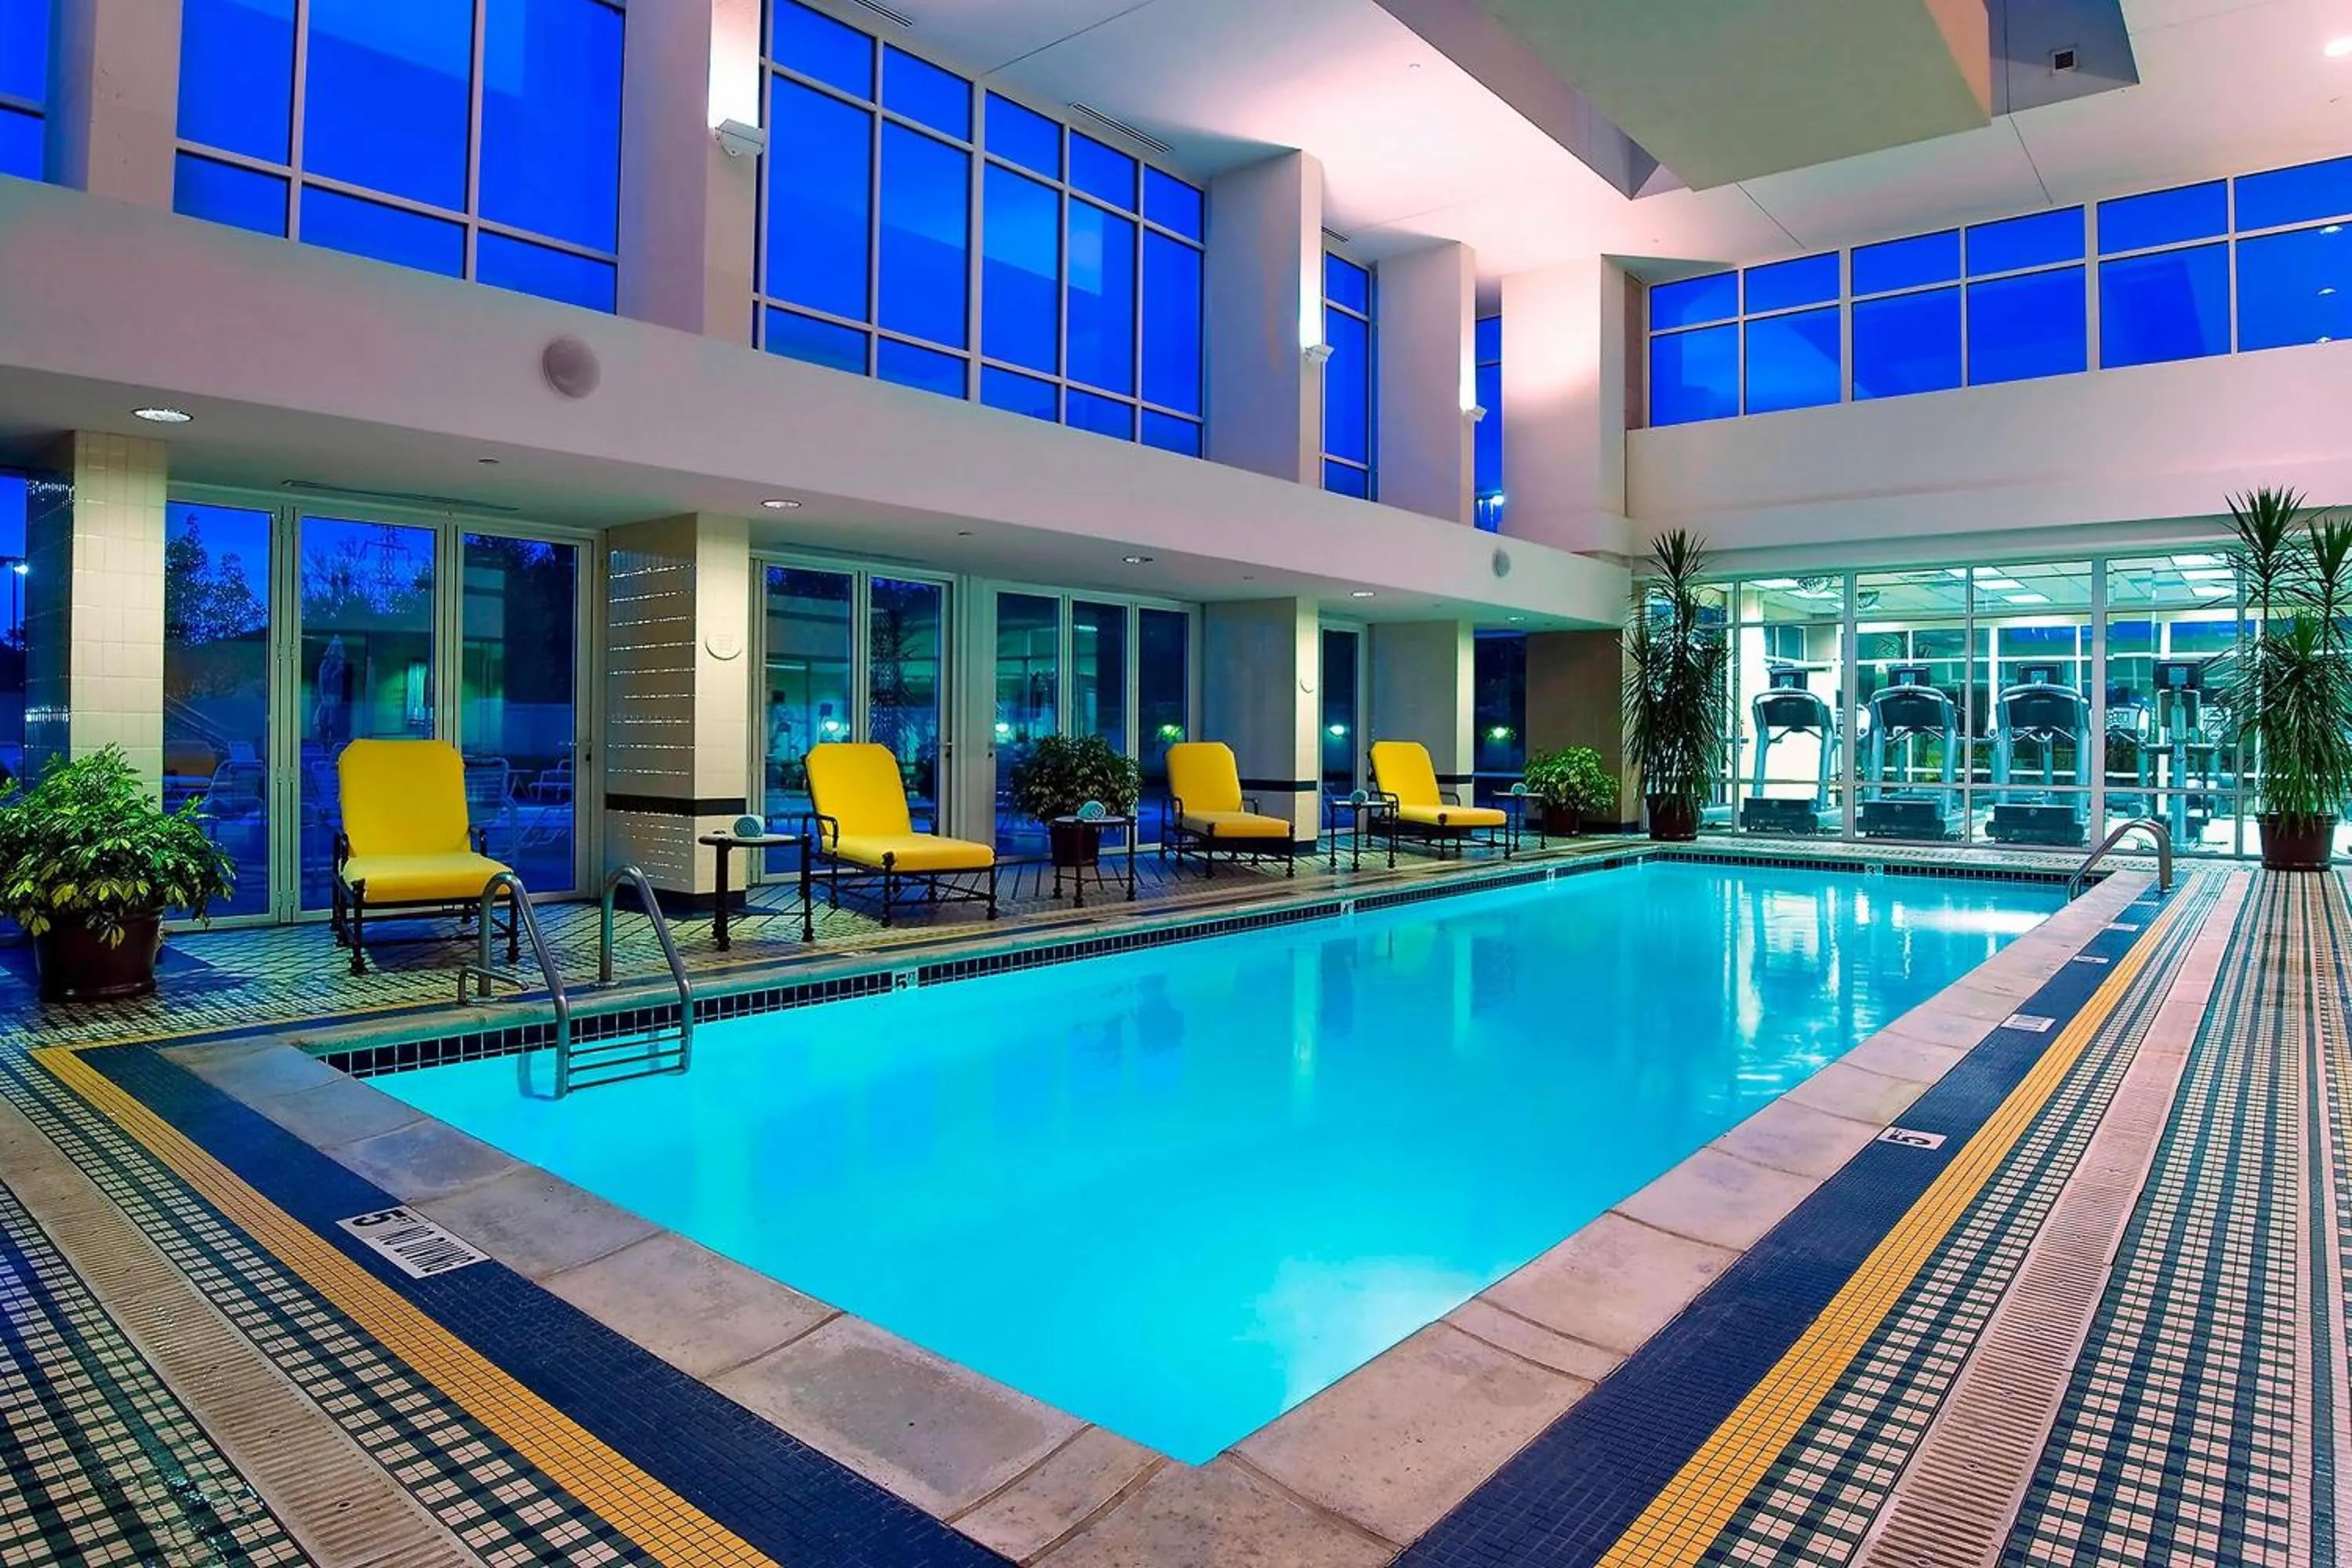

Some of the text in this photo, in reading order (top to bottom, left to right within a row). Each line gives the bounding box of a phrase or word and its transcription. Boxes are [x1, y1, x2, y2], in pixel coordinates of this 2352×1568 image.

[895, 973, 907, 989] 5
[1887, 1134, 1931, 1145] 5
[352, 1209, 409, 1227] 5
[376, 1225, 436, 1246] NO
[393, 1236, 477, 1273] DIVING
